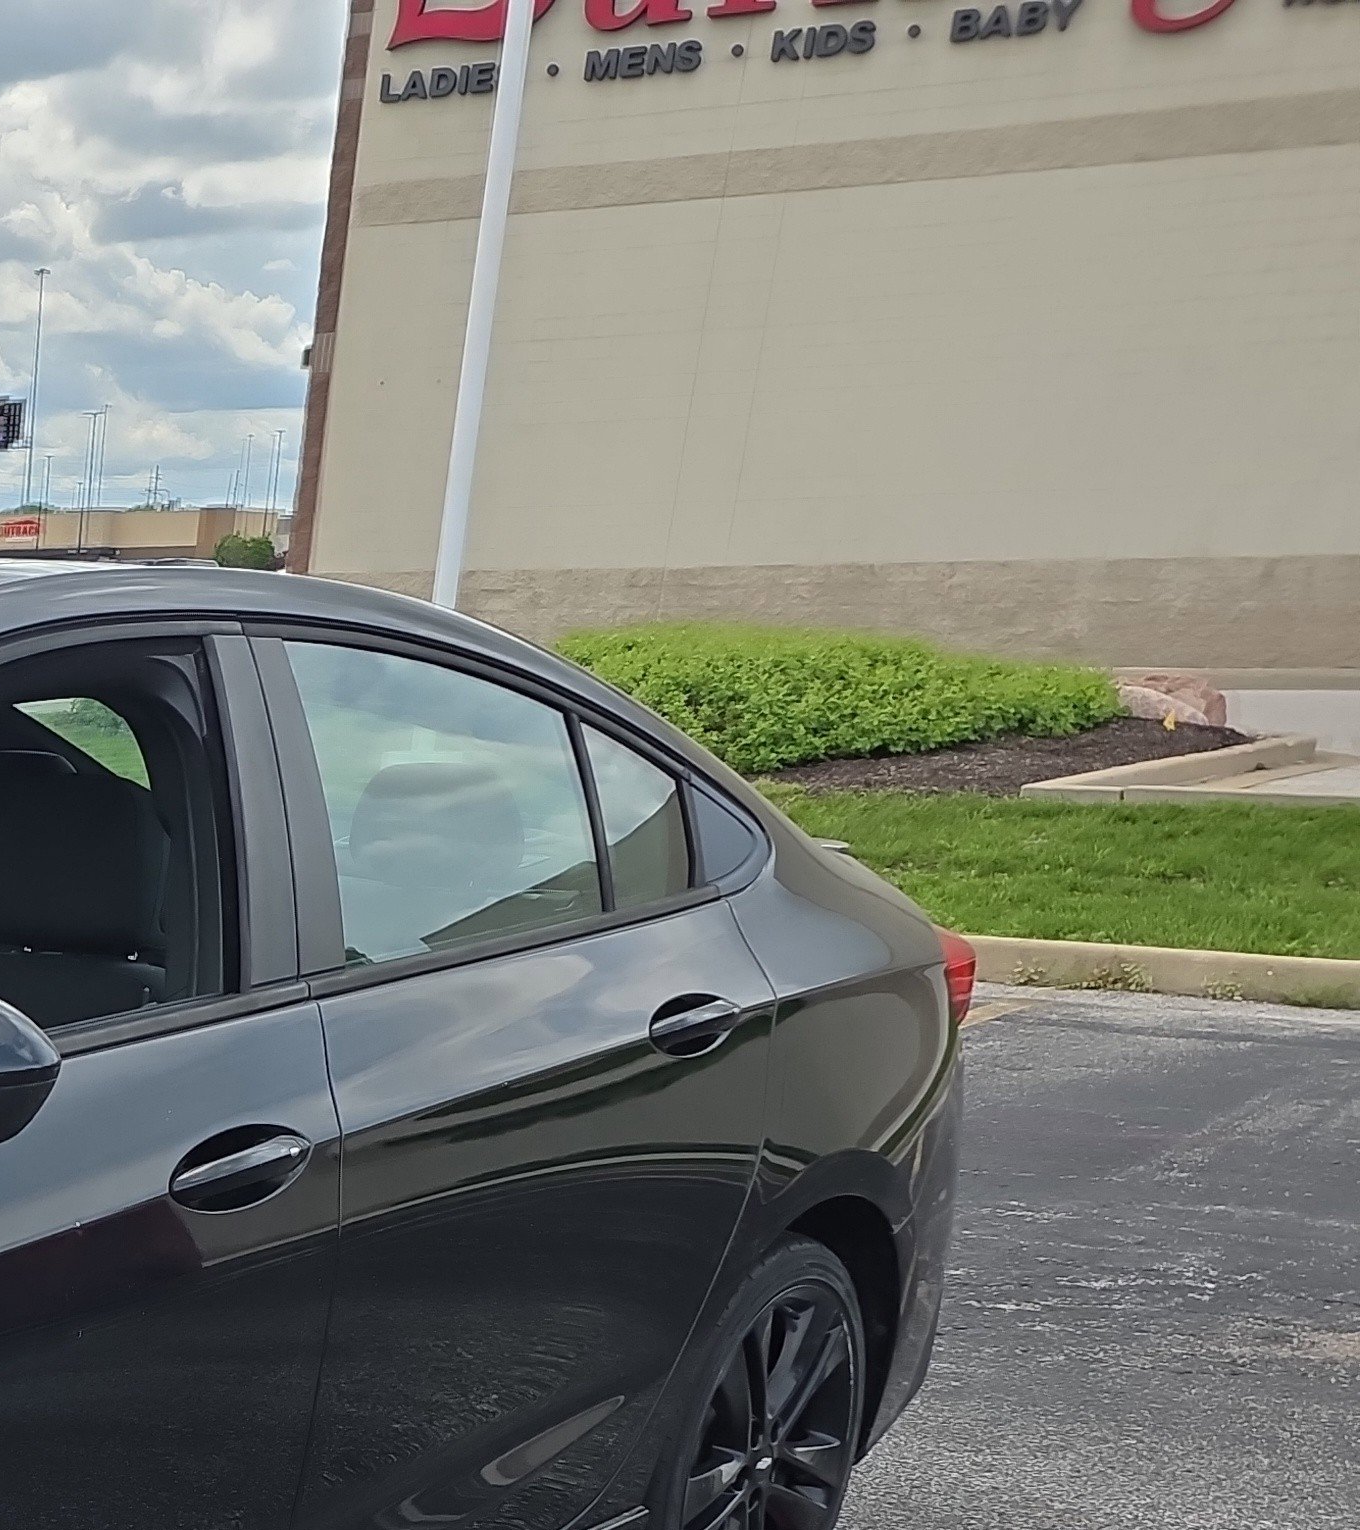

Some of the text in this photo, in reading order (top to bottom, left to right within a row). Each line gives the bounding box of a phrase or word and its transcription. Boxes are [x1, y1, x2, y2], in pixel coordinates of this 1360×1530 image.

[379, 62, 502, 103] LADIE
[583, 40, 703, 82] MENS
[770, 20, 877, 63] KIDS
[950, 0, 1083, 43] BABY
